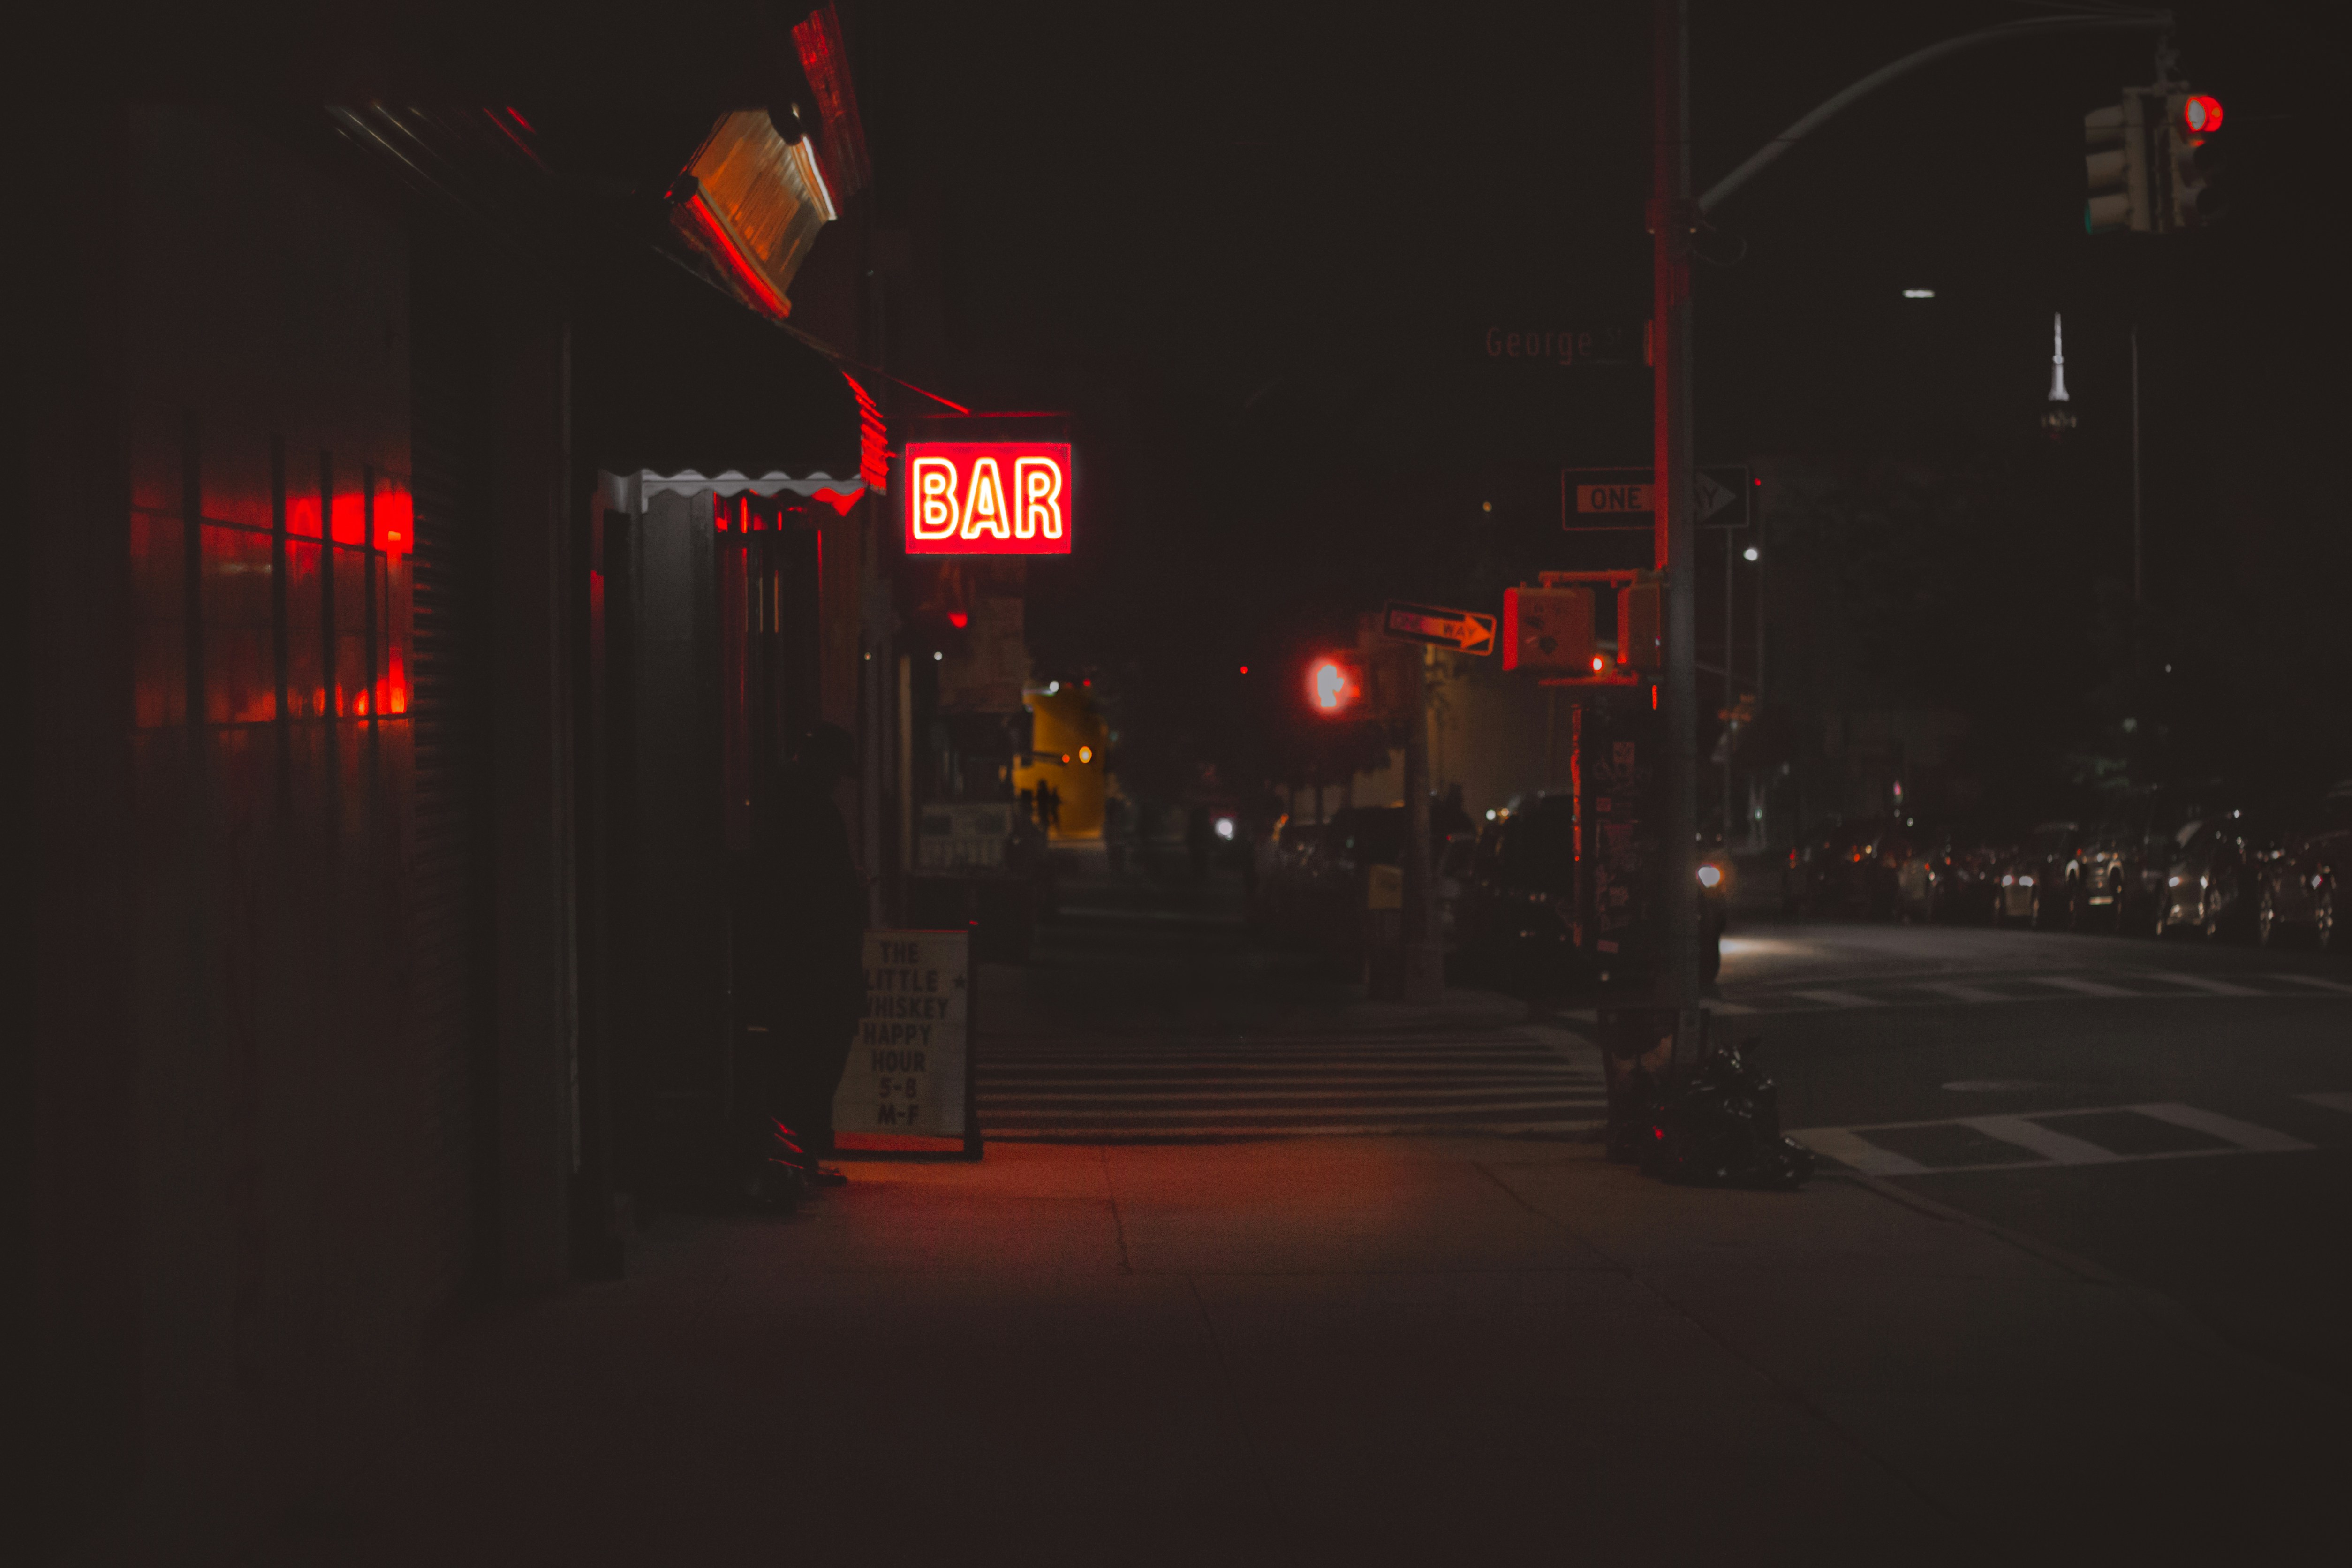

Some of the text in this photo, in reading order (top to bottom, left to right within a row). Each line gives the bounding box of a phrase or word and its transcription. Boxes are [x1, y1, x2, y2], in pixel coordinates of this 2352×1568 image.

[1485, 327, 1592, 366] George
[912, 456, 1063, 540] BAR
[1591, 487, 1642, 509] ONE
[879, 942, 918, 963] THE
[864, 969, 937, 991] LITTLE
[864, 1023, 930, 1046] HAPPY
[872, 1050, 925, 1072] HOUR
[879, 1078, 915, 1098] 5-8
[878, 1104, 918, 1124] M-F
